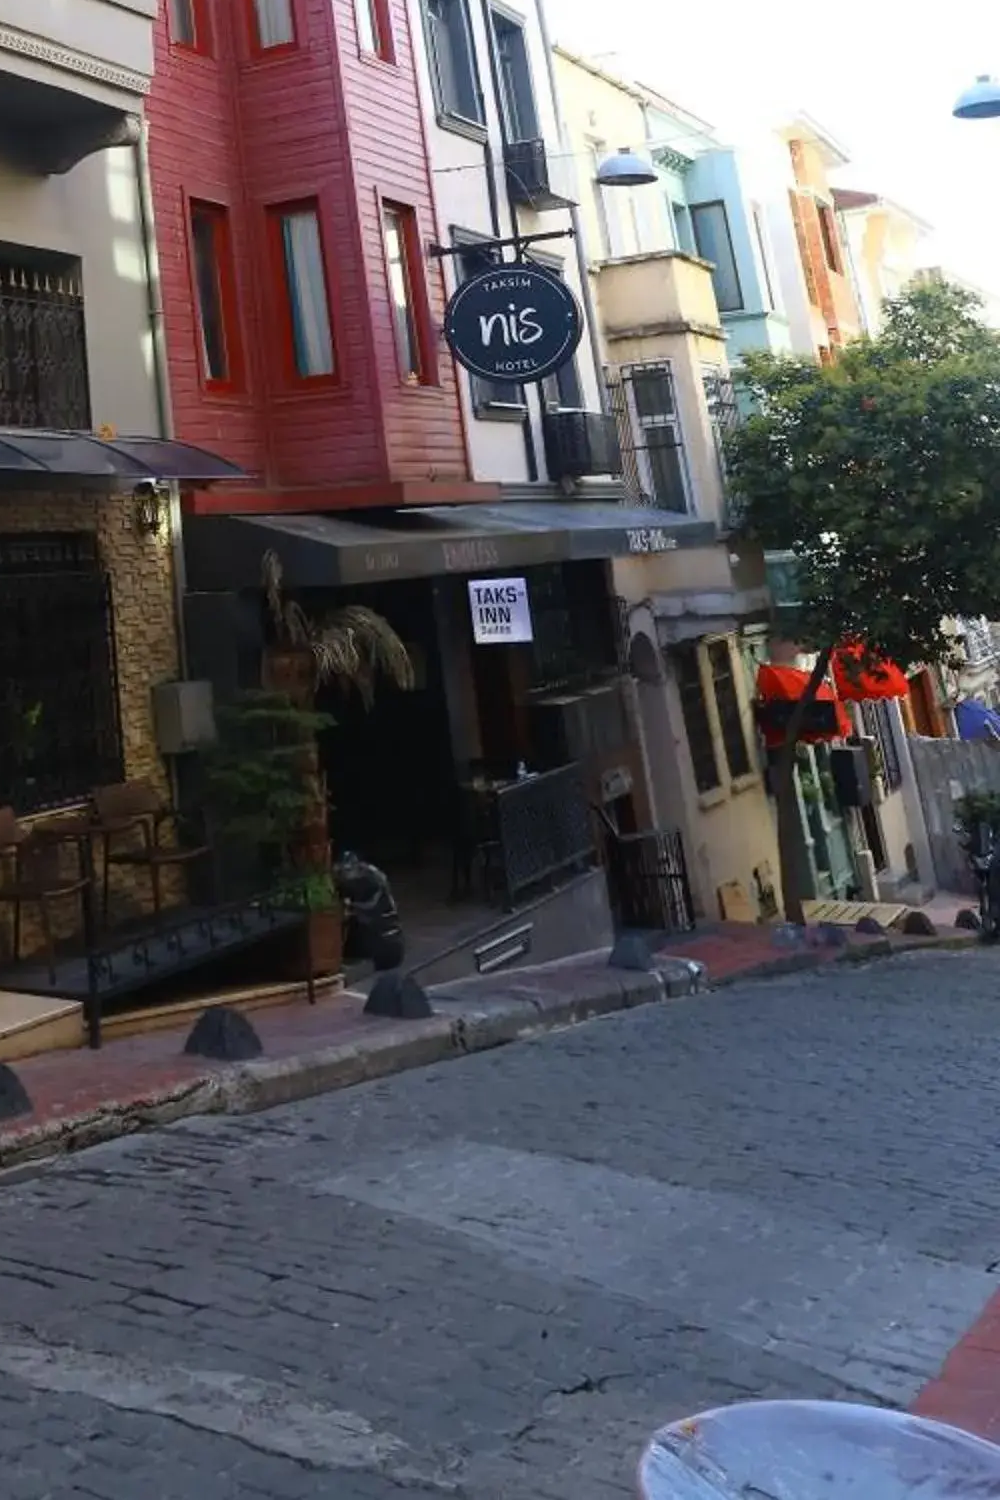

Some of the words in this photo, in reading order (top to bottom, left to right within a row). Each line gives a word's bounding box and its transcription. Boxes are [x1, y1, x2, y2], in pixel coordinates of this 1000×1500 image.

[479, 303, 543, 346] nis
[495, 357, 538, 371] HOTEL
[480, 607, 511, 624] INN
